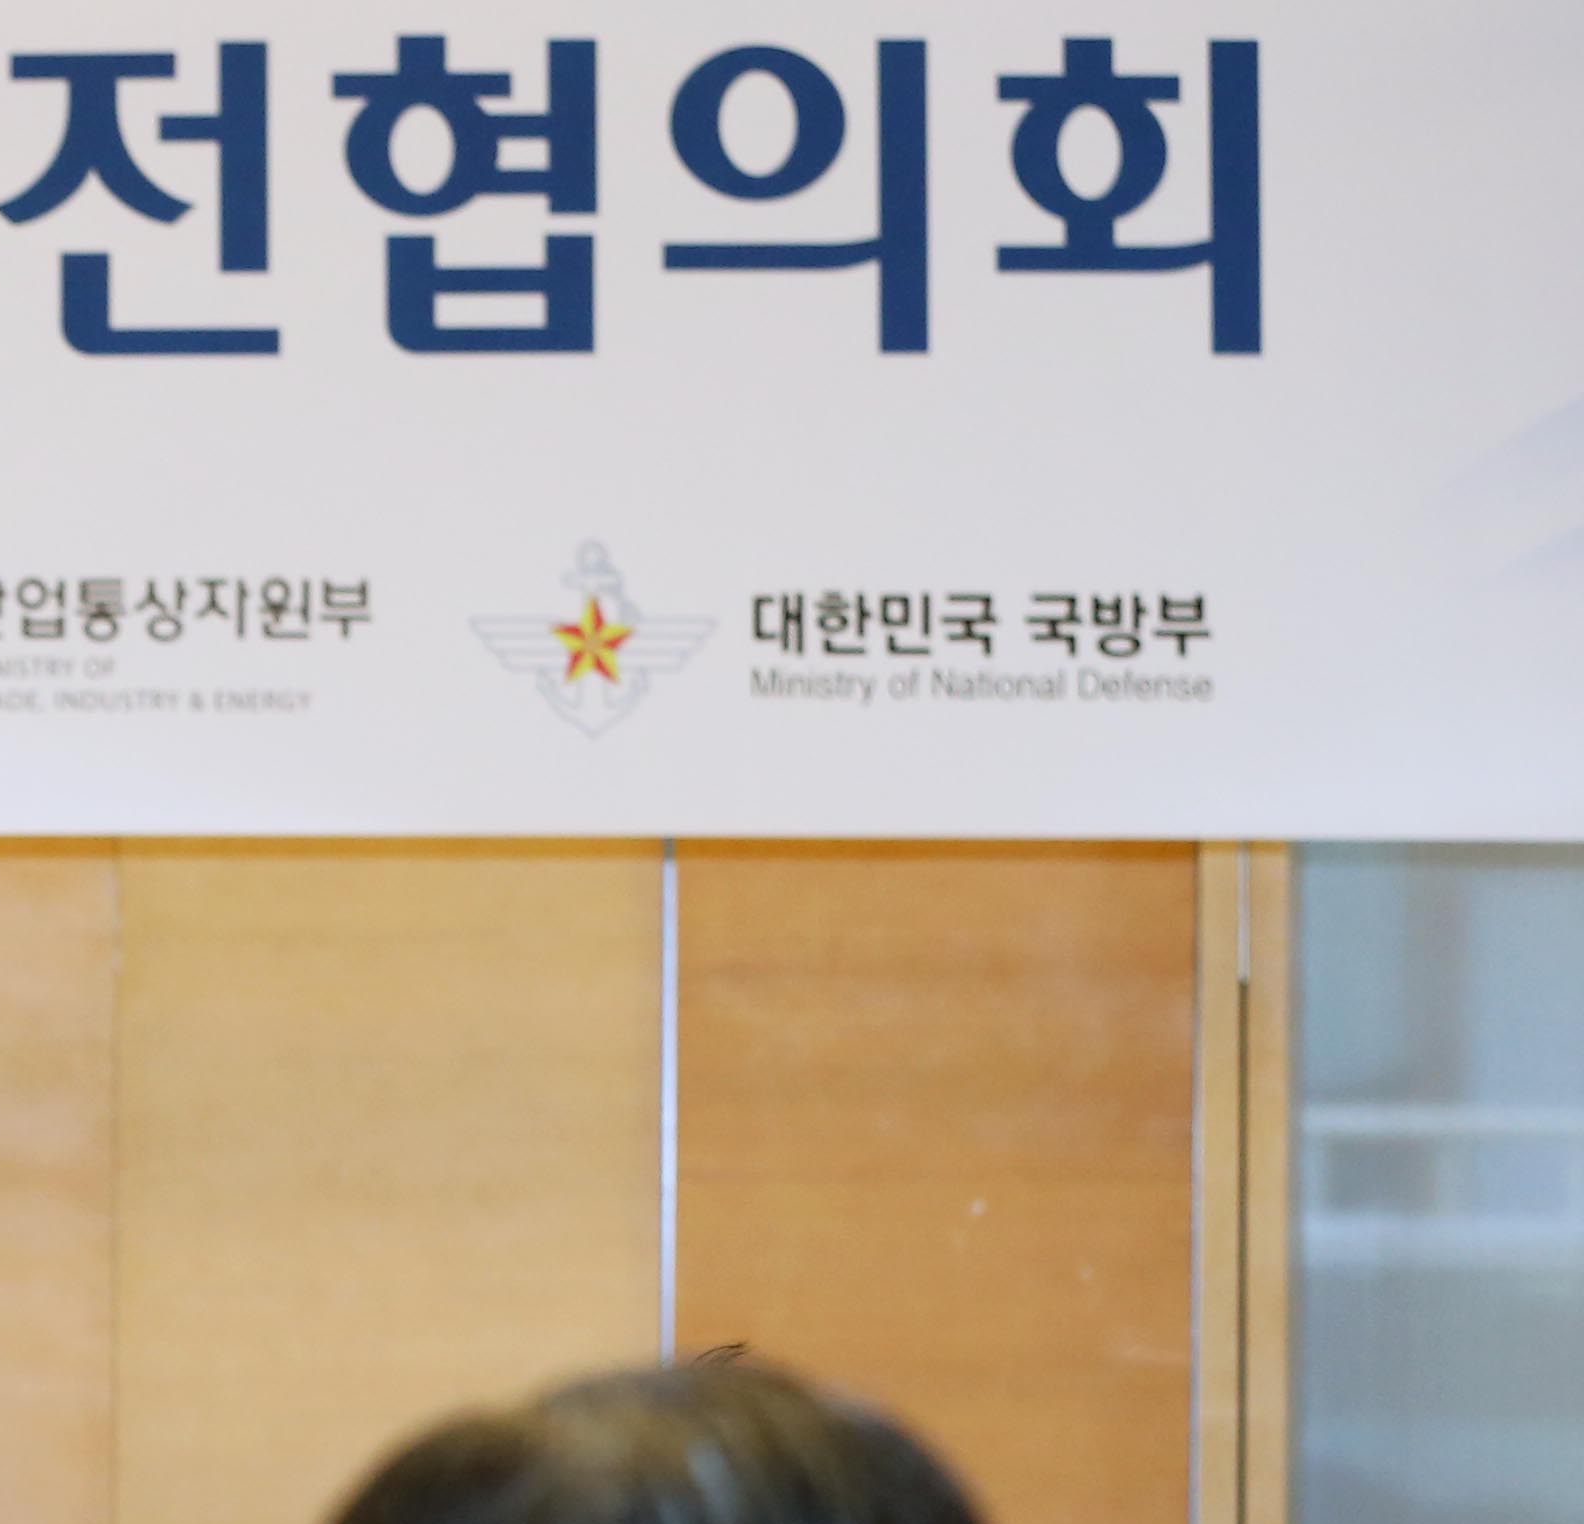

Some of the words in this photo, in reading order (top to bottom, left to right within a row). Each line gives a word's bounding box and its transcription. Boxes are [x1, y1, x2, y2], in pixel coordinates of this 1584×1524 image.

[750, 592, 1001, 657] 대한민국
[1024, 592, 1213, 658] 국방부
[82, 657, 117, 679] OF
[53, 689, 179, 712] INDUSTRY
[188, 690, 206, 712] &
[212, 690, 312, 712] ENERGY
[750, 667, 876, 705] Ministry
[886, 667, 922, 701] of
[930, 667, 1065, 701] National
[1076, 667, 1214, 701] Defense
